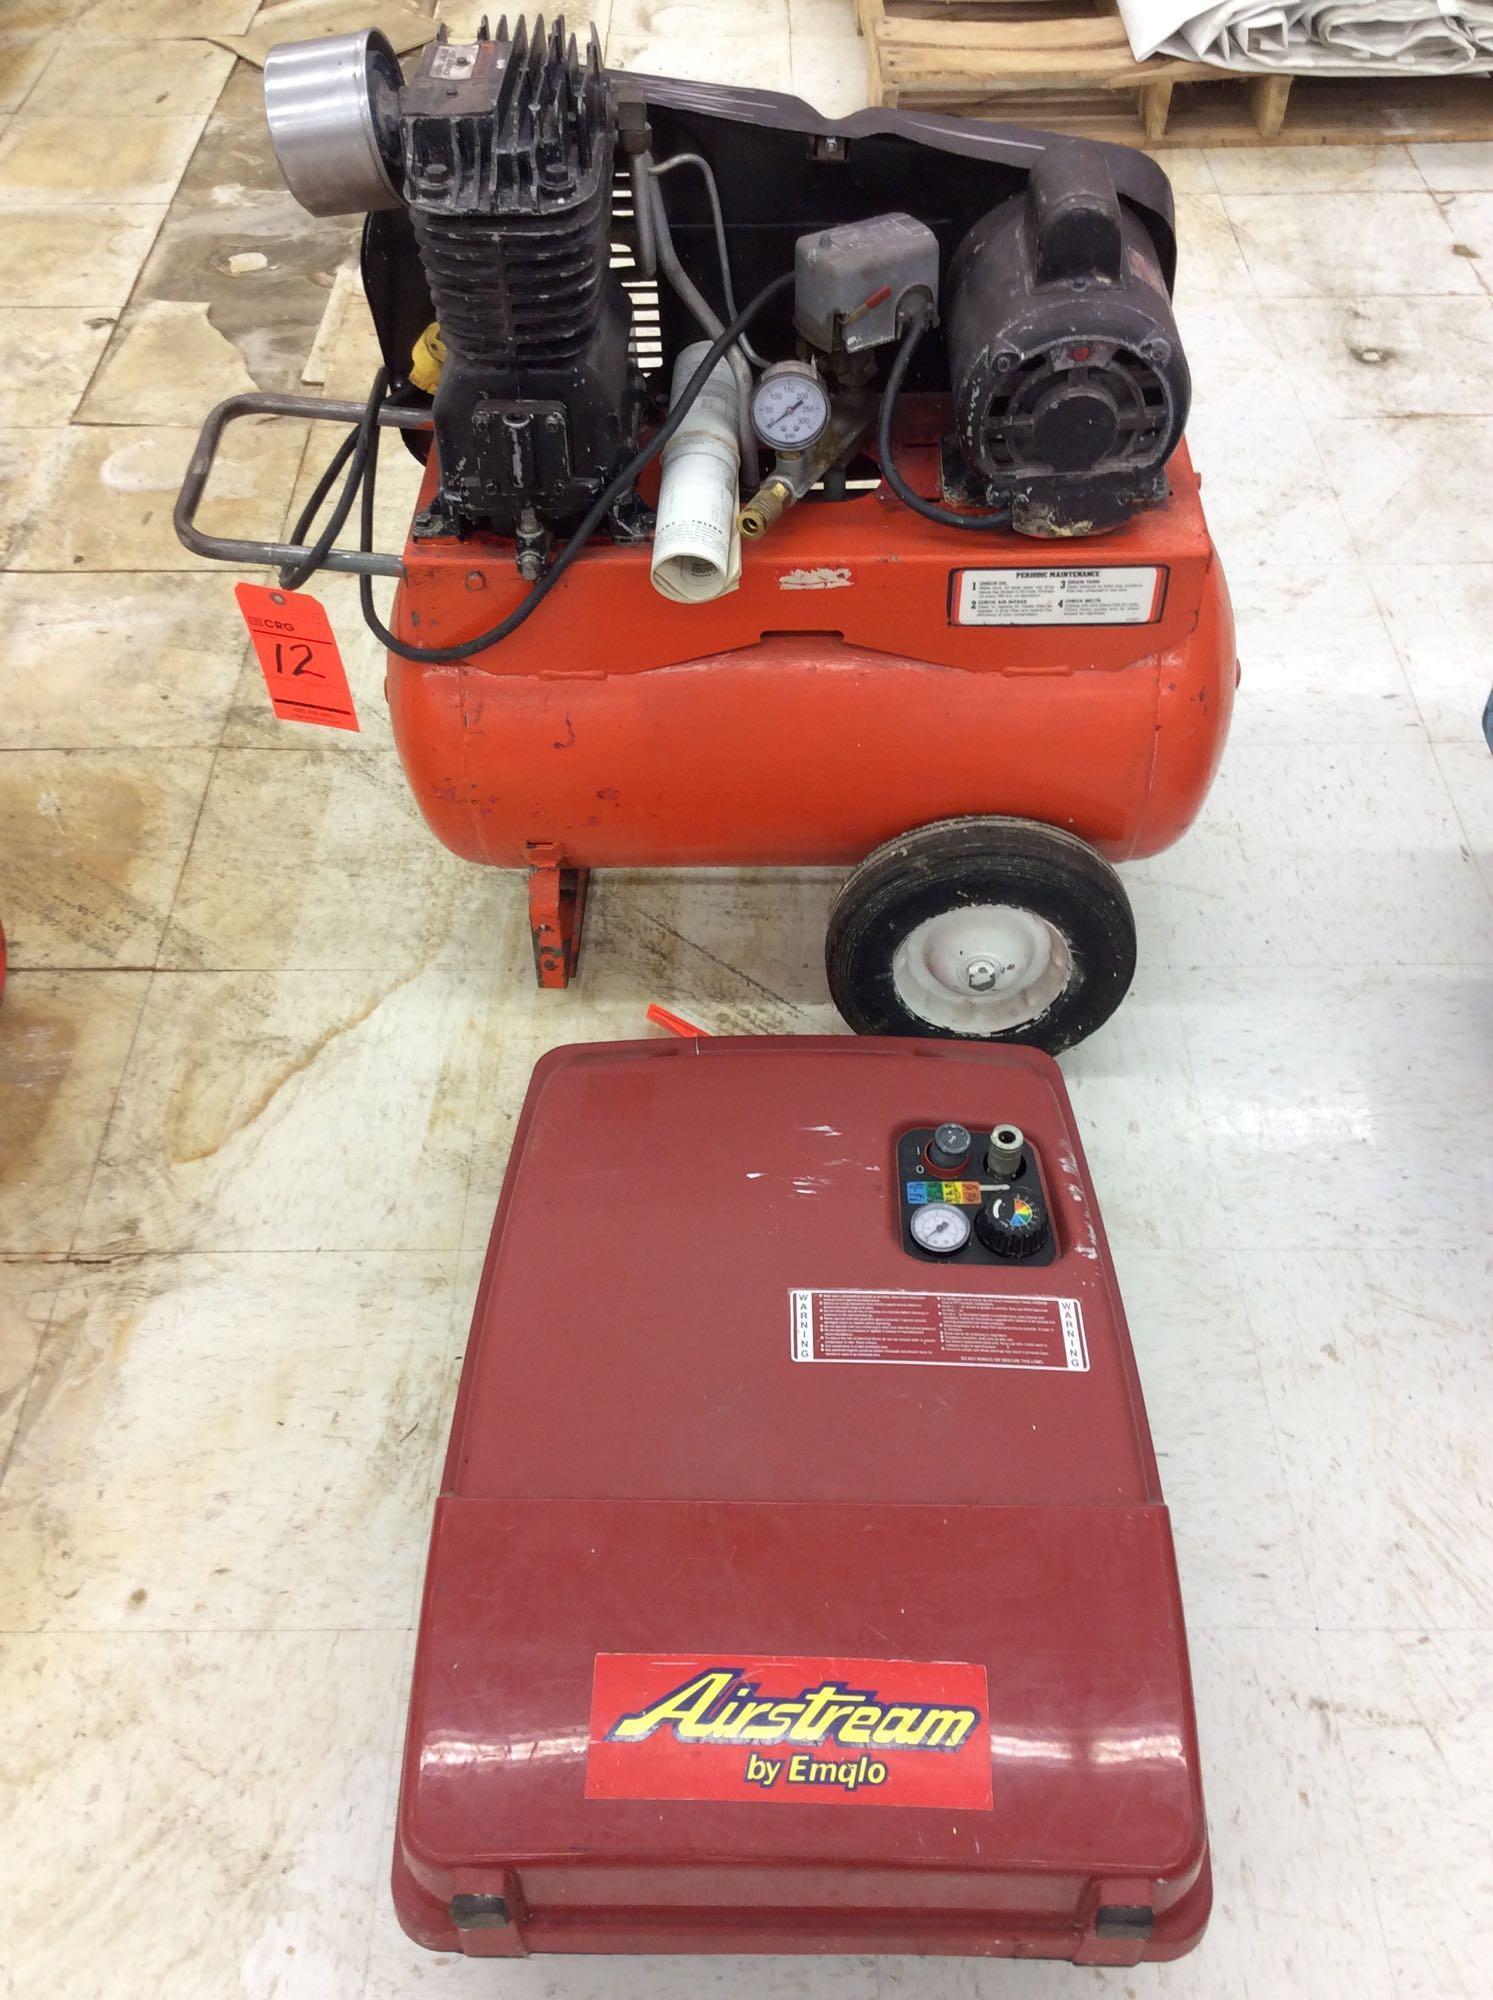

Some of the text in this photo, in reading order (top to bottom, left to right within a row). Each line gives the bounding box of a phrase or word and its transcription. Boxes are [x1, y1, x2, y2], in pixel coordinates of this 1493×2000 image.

[796, 392, 809, 400] 200
[972, 581, 976, 591] 1
[1060, 580, 1066, 589] 3
[971, 600, 977, 609] 2
[1057, 599, 1064, 608] 4
[264, 619, 295, 632] CRG
[275, 643, 326, 679] 12
[798, 1293, 809, 1358] WARNING
[1061, 1301, 1080, 1367] WARNING
[608, 1669, 979, 1750] Airstream
[747, 1754, 780, 1785] by
